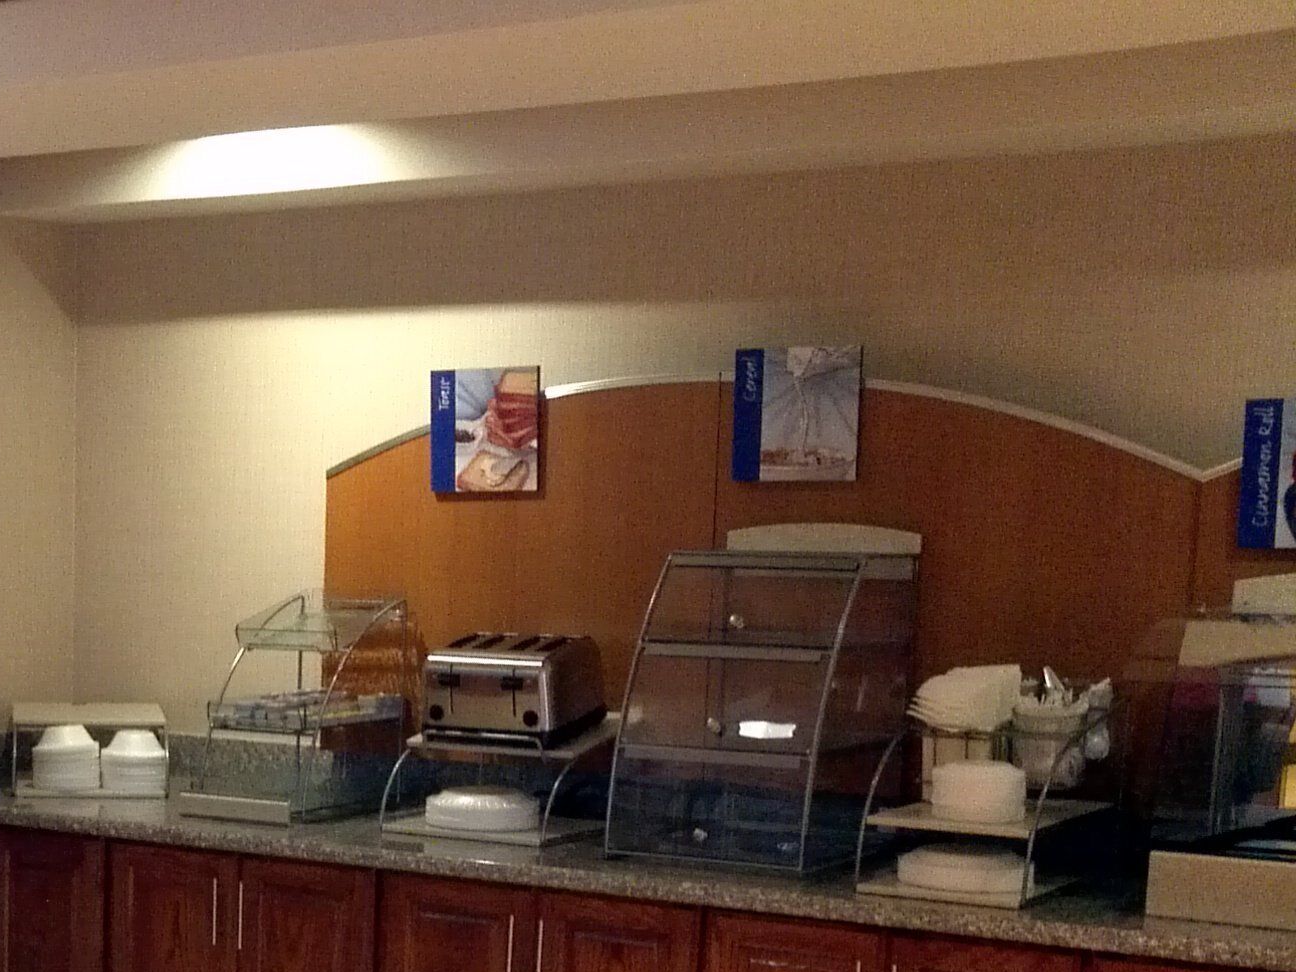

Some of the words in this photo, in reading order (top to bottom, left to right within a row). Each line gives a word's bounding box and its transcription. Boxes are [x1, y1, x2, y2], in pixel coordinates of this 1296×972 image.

[438, 376, 451, 411] Toast
[742, 357, 757, 402] Cereal
[1253, 406, 1274, 436] Roll
[1251, 440, 1272, 526] Cinnamon
